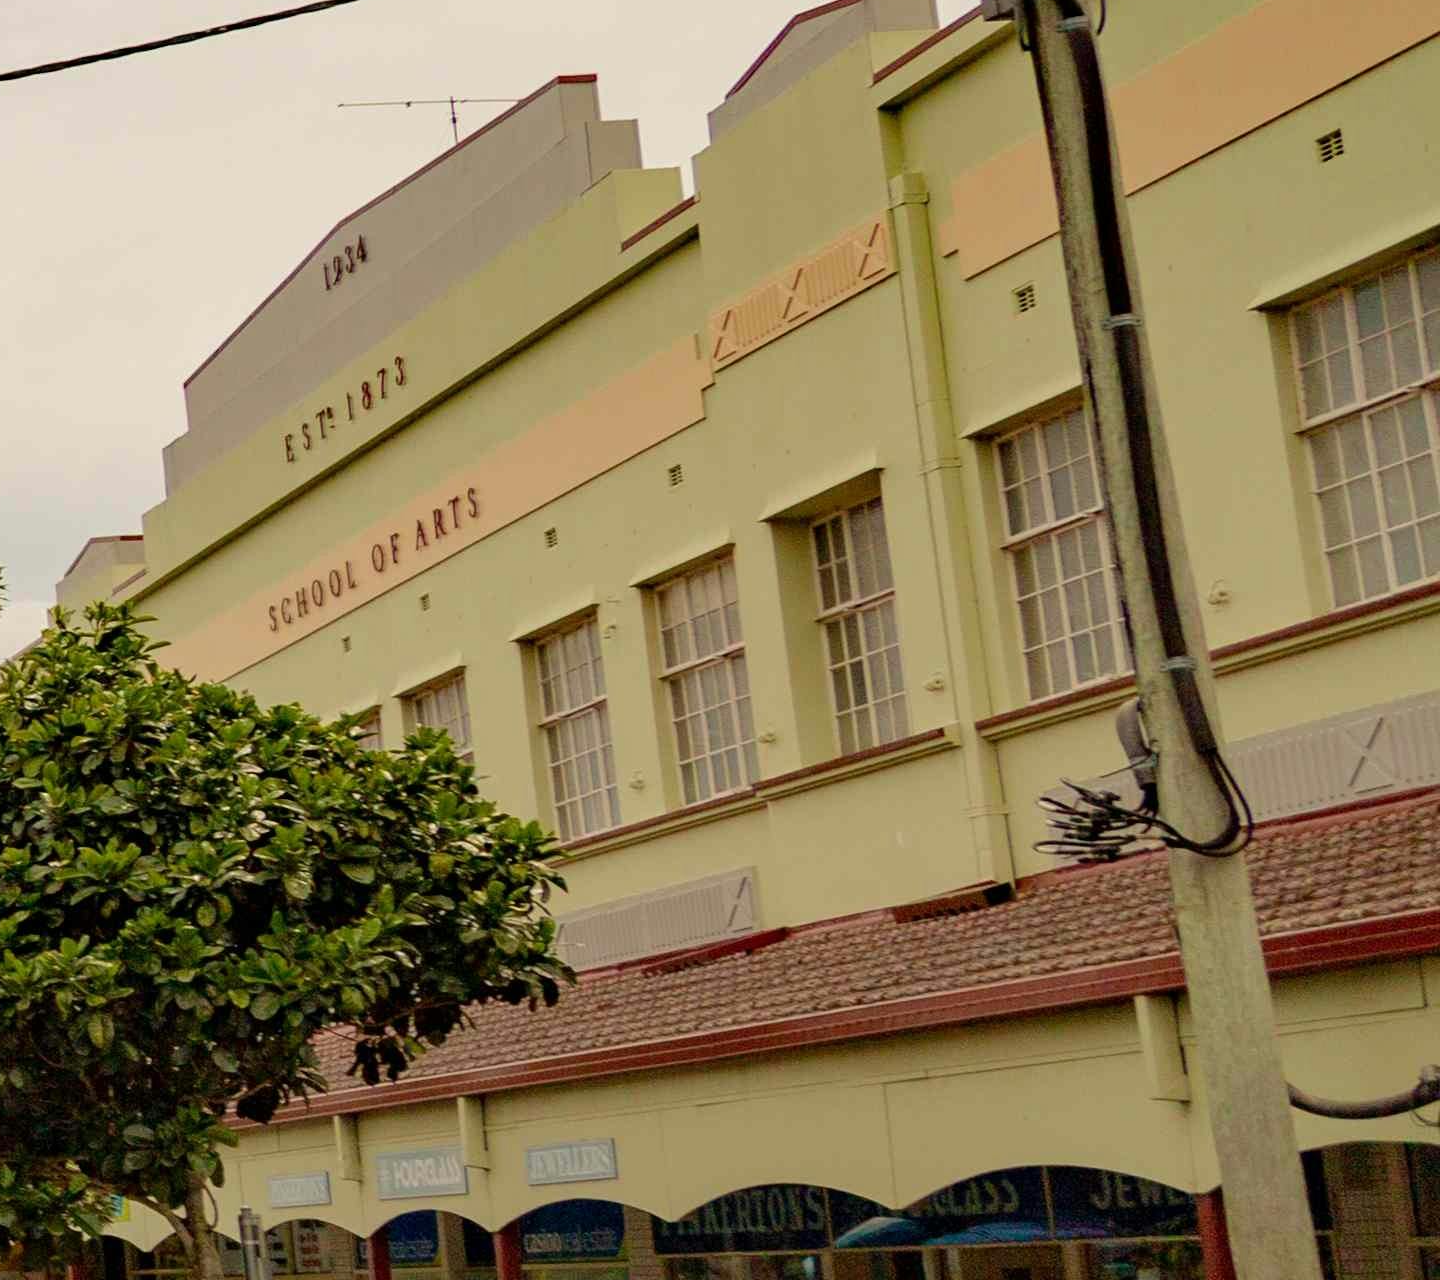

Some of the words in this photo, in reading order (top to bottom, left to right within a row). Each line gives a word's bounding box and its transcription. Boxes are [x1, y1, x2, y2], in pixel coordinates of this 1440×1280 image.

[346, 355, 406, 422] 1873
[268, 560, 358, 632] SCHOOL
[370, 532, 400, 573] OF
[415, 487, 481, 551] ARTS
[529, 1144, 611, 1179] JEWELLERS
